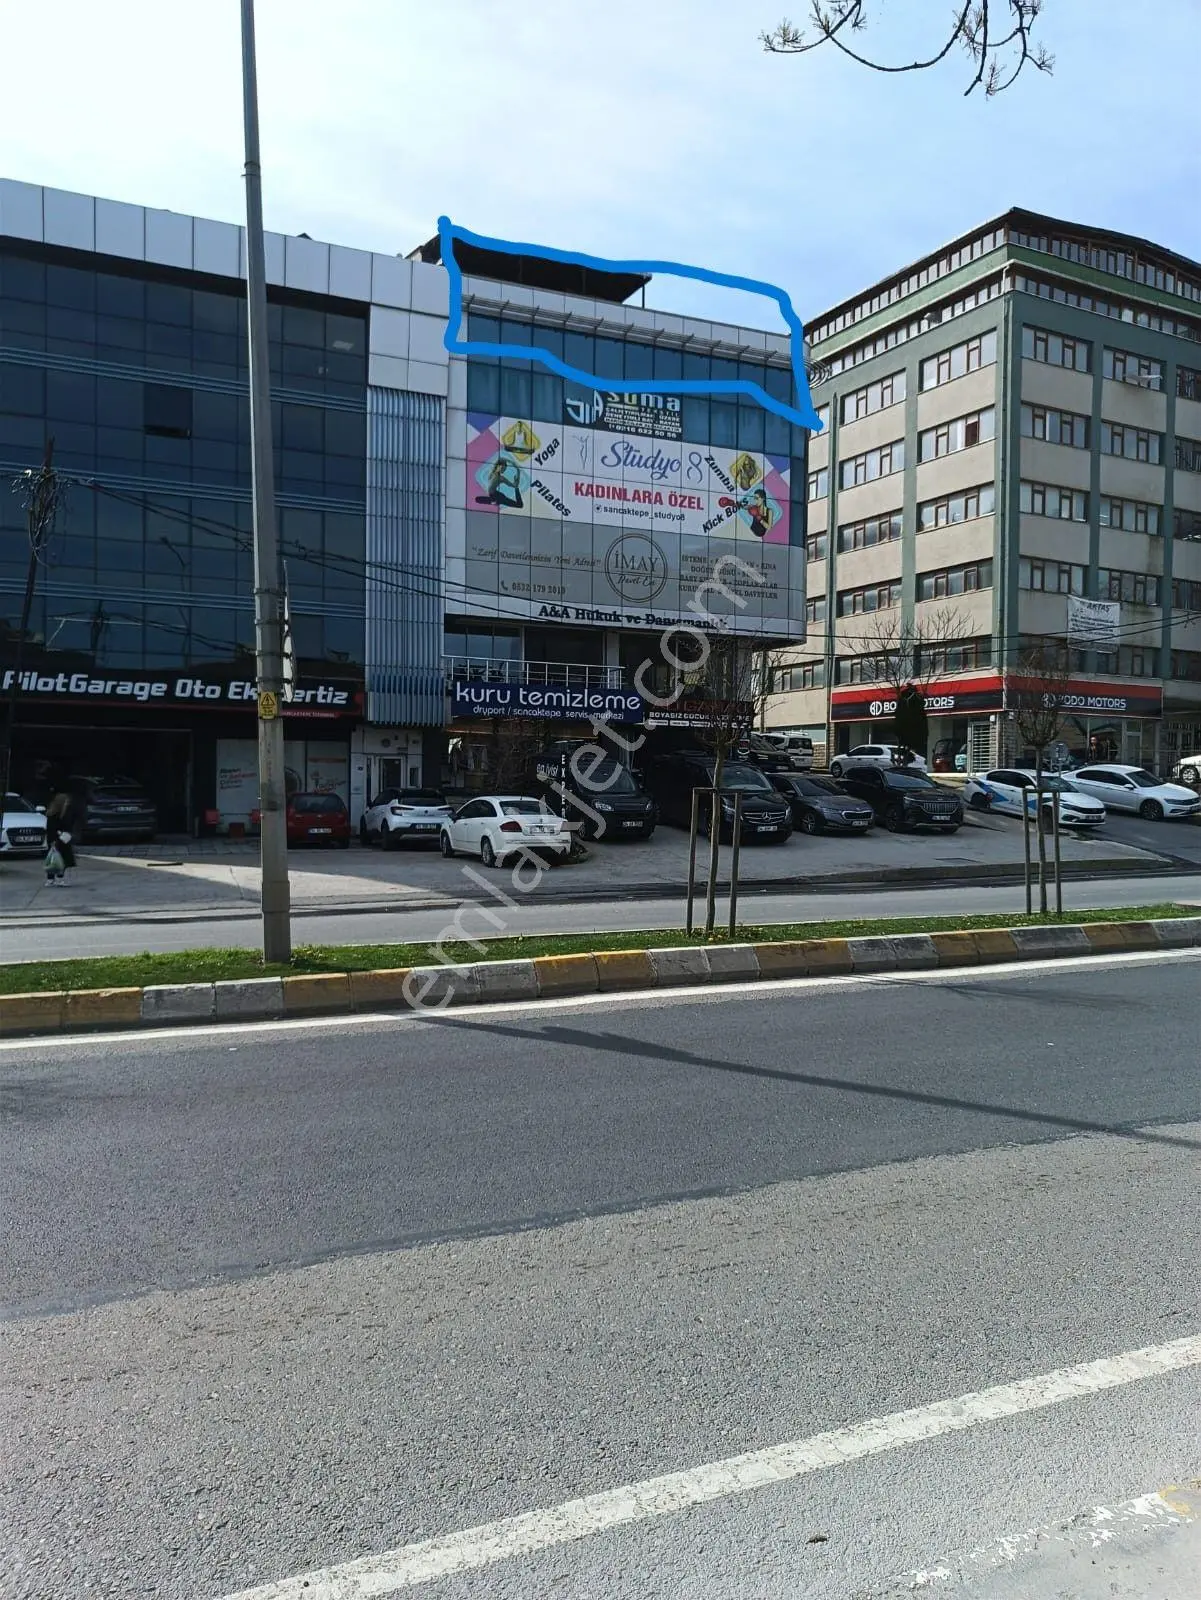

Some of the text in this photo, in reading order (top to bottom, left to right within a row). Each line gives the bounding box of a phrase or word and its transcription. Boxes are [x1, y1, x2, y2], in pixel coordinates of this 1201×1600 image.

[534, 437, 561, 466] Yoga
[704, 453, 735, 493] Zumba
[530, 479, 571, 517] Pilates
[574, 482, 704, 511] KADINLARA ÖZEL
[702, 514, 724, 534] Kick
[615, 550, 660, 572] İMAY
[539, 605, 571, 619] A&A
[575, 607, 622, 623] Hukuk
[625, 614, 641, 625] ve
[2, 670, 168, 701] PilotGarage
[175, 679, 222, 699] Oto
[456, 682, 641, 710] kuru temizleme
[473, 705, 505, 716] dryport
[1087, 697, 1127, 709] MOTORS
